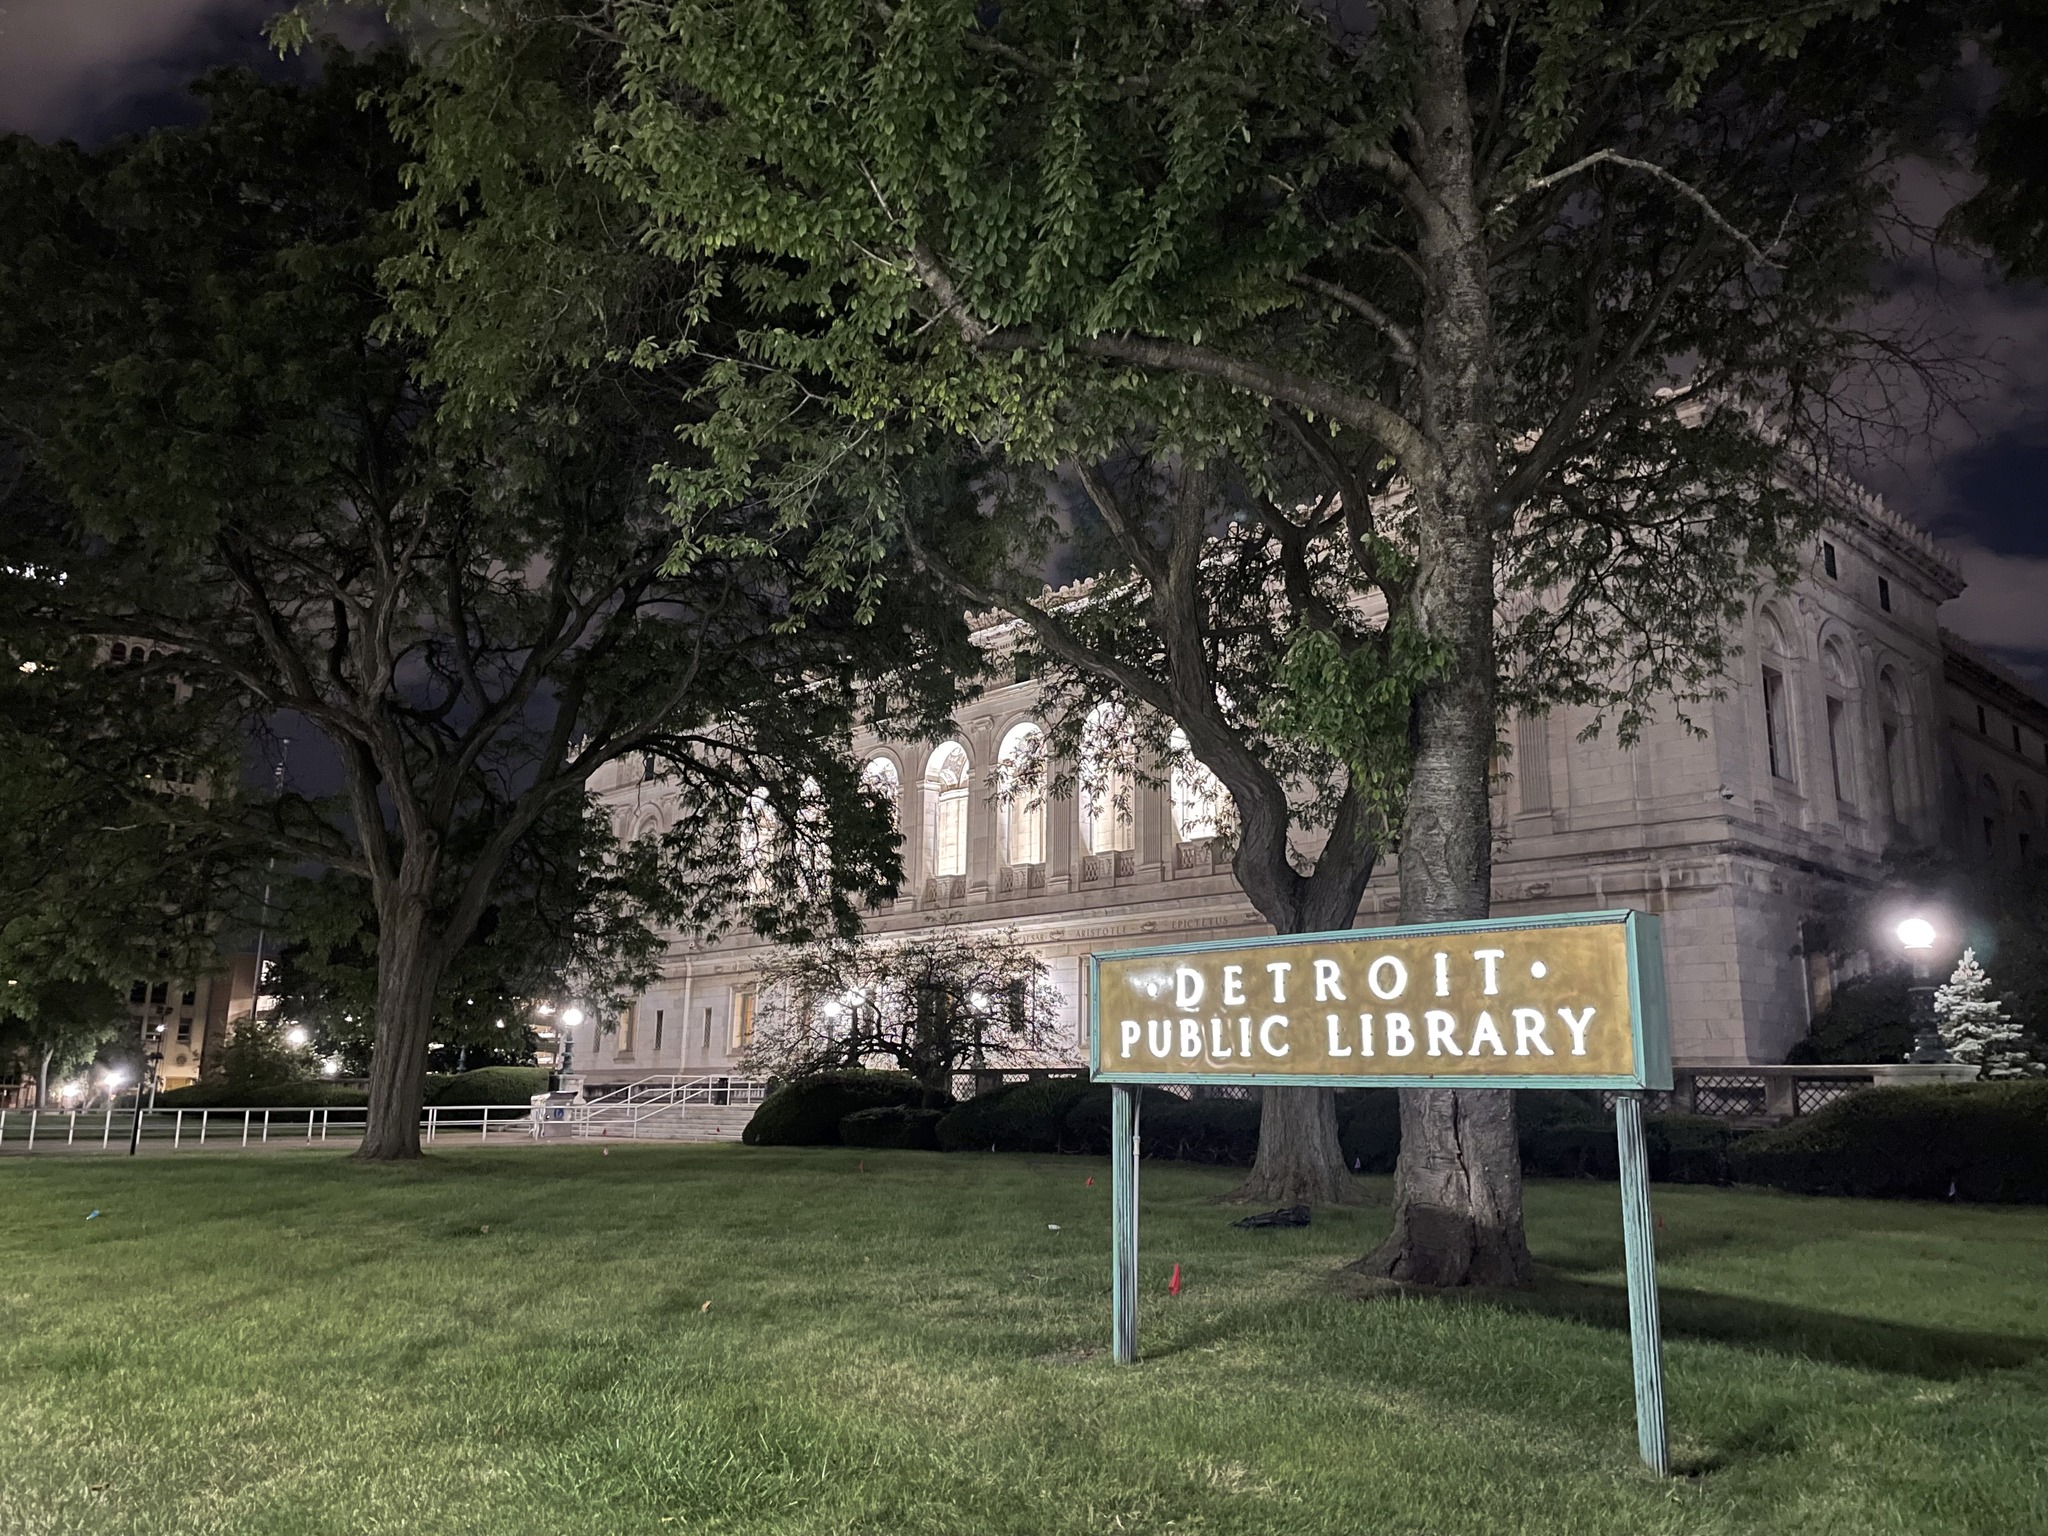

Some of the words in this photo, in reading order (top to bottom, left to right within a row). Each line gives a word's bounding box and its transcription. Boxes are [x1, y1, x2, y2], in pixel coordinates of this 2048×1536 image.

[1075, 925, 1127, 938] ARISTOTLE
[1171, 915, 1228, 929] EPICTETUS
[1175, 949, 1505, 1007] DETROIT
[1120, 1015, 1290, 1059] PUBLIC
[1326, 1007, 1596, 1057] LIBRARY
